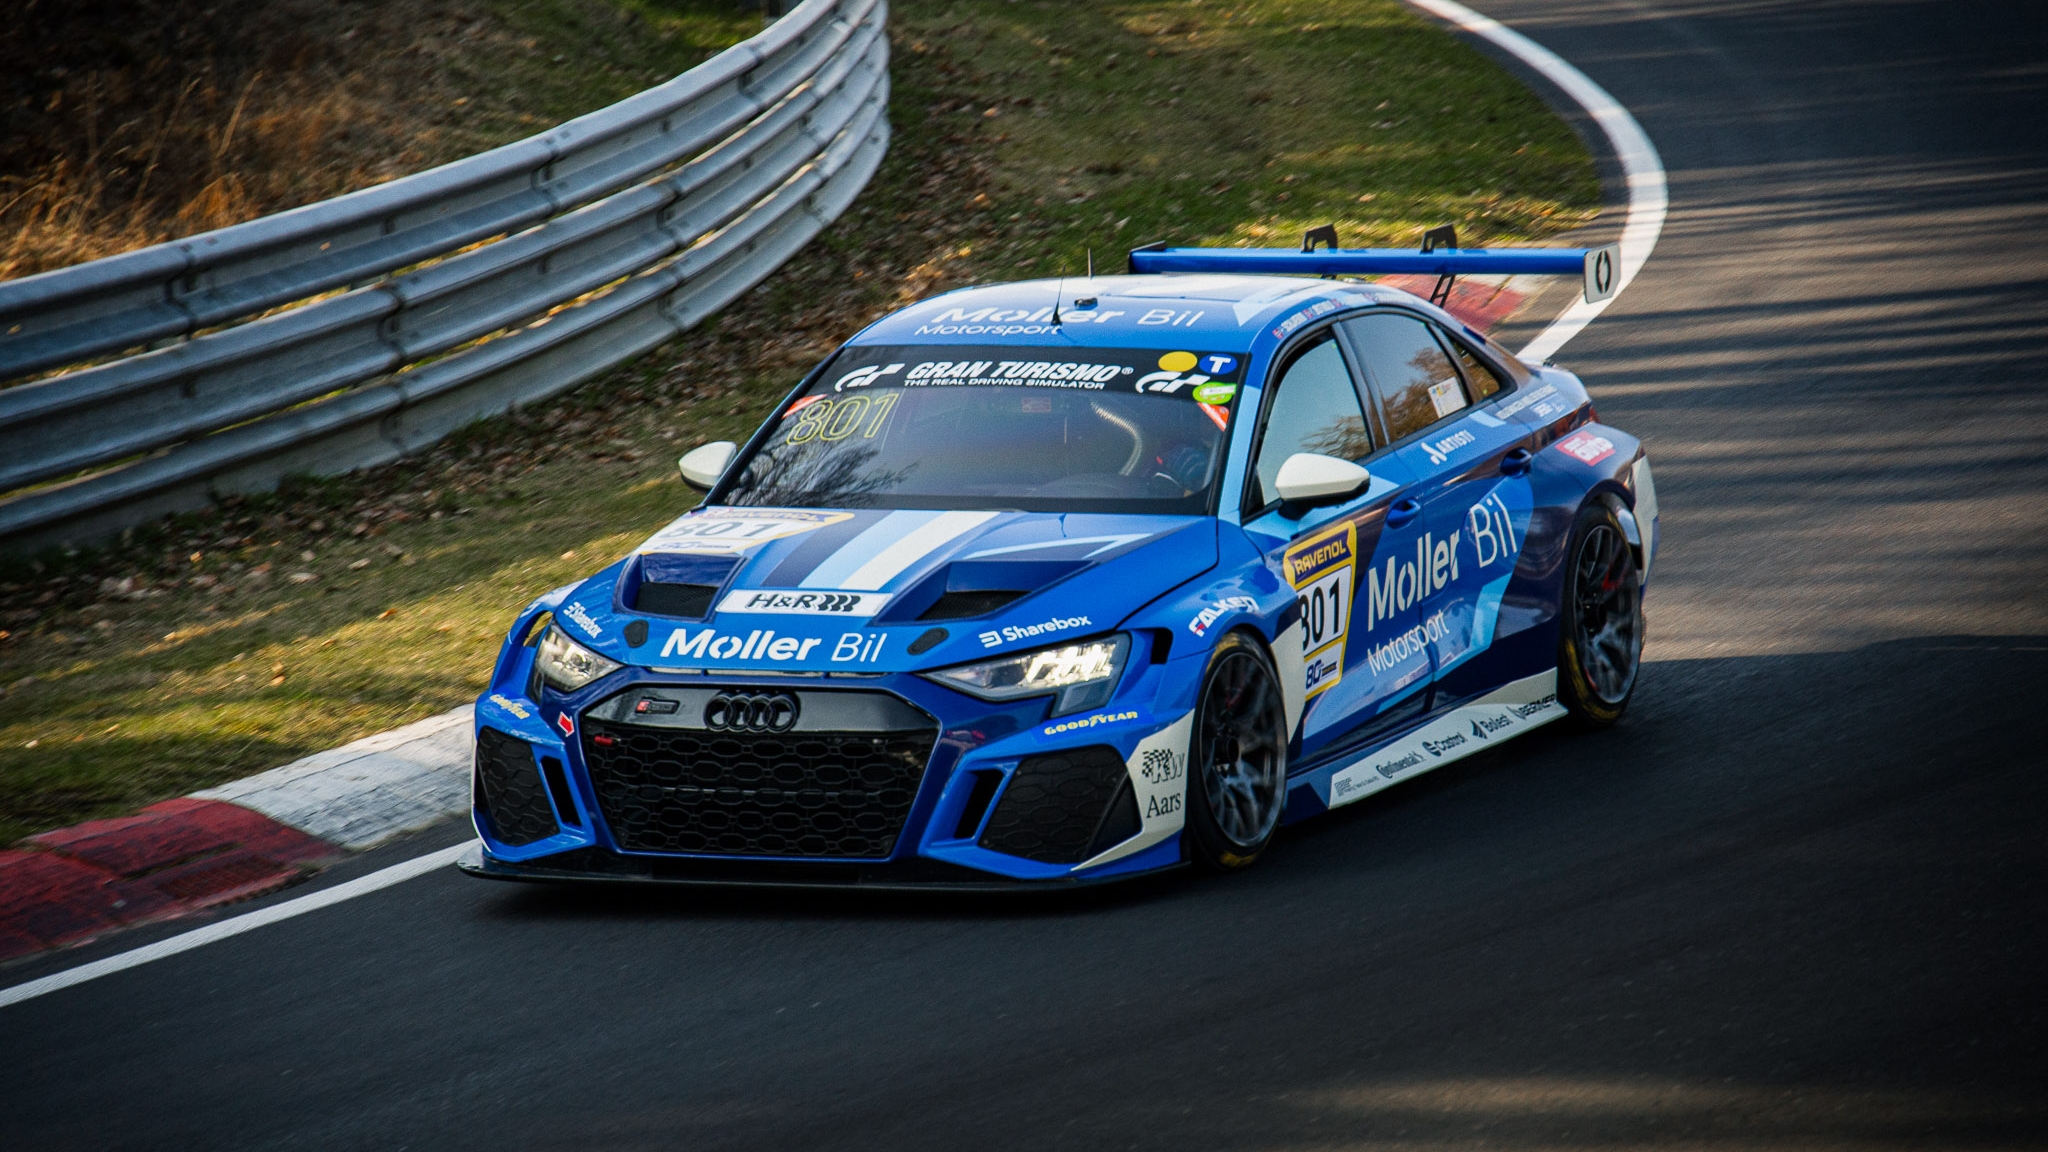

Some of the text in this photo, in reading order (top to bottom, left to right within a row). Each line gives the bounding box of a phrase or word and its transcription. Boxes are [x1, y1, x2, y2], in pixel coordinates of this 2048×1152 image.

[914, 324, 1065, 336] Motorsport
[1136, 308, 1205, 327] Bil
[906, 361, 994, 379] GRAN
[904, 379, 929, 387] THE
[967, 379, 1024, 387] DRIVING
[1025, 379, 1106, 389] SIMULATOR
[786, 393, 900, 446] 801
[659, 522, 782, 539] 801
[1468, 492, 1518, 569] Bil
[1294, 540, 1347, 575] RAVENOL
[749, 593, 818, 609] H&R
[1001, 615, 1093, 642] Sharebox
[831, 633, 888, 663] Bil
[1367, 608, 1451, 677] Motorsport
[1044, 711, 1139, 736] GOODYEAR
[1146, 792, 1182, 819] Aars
